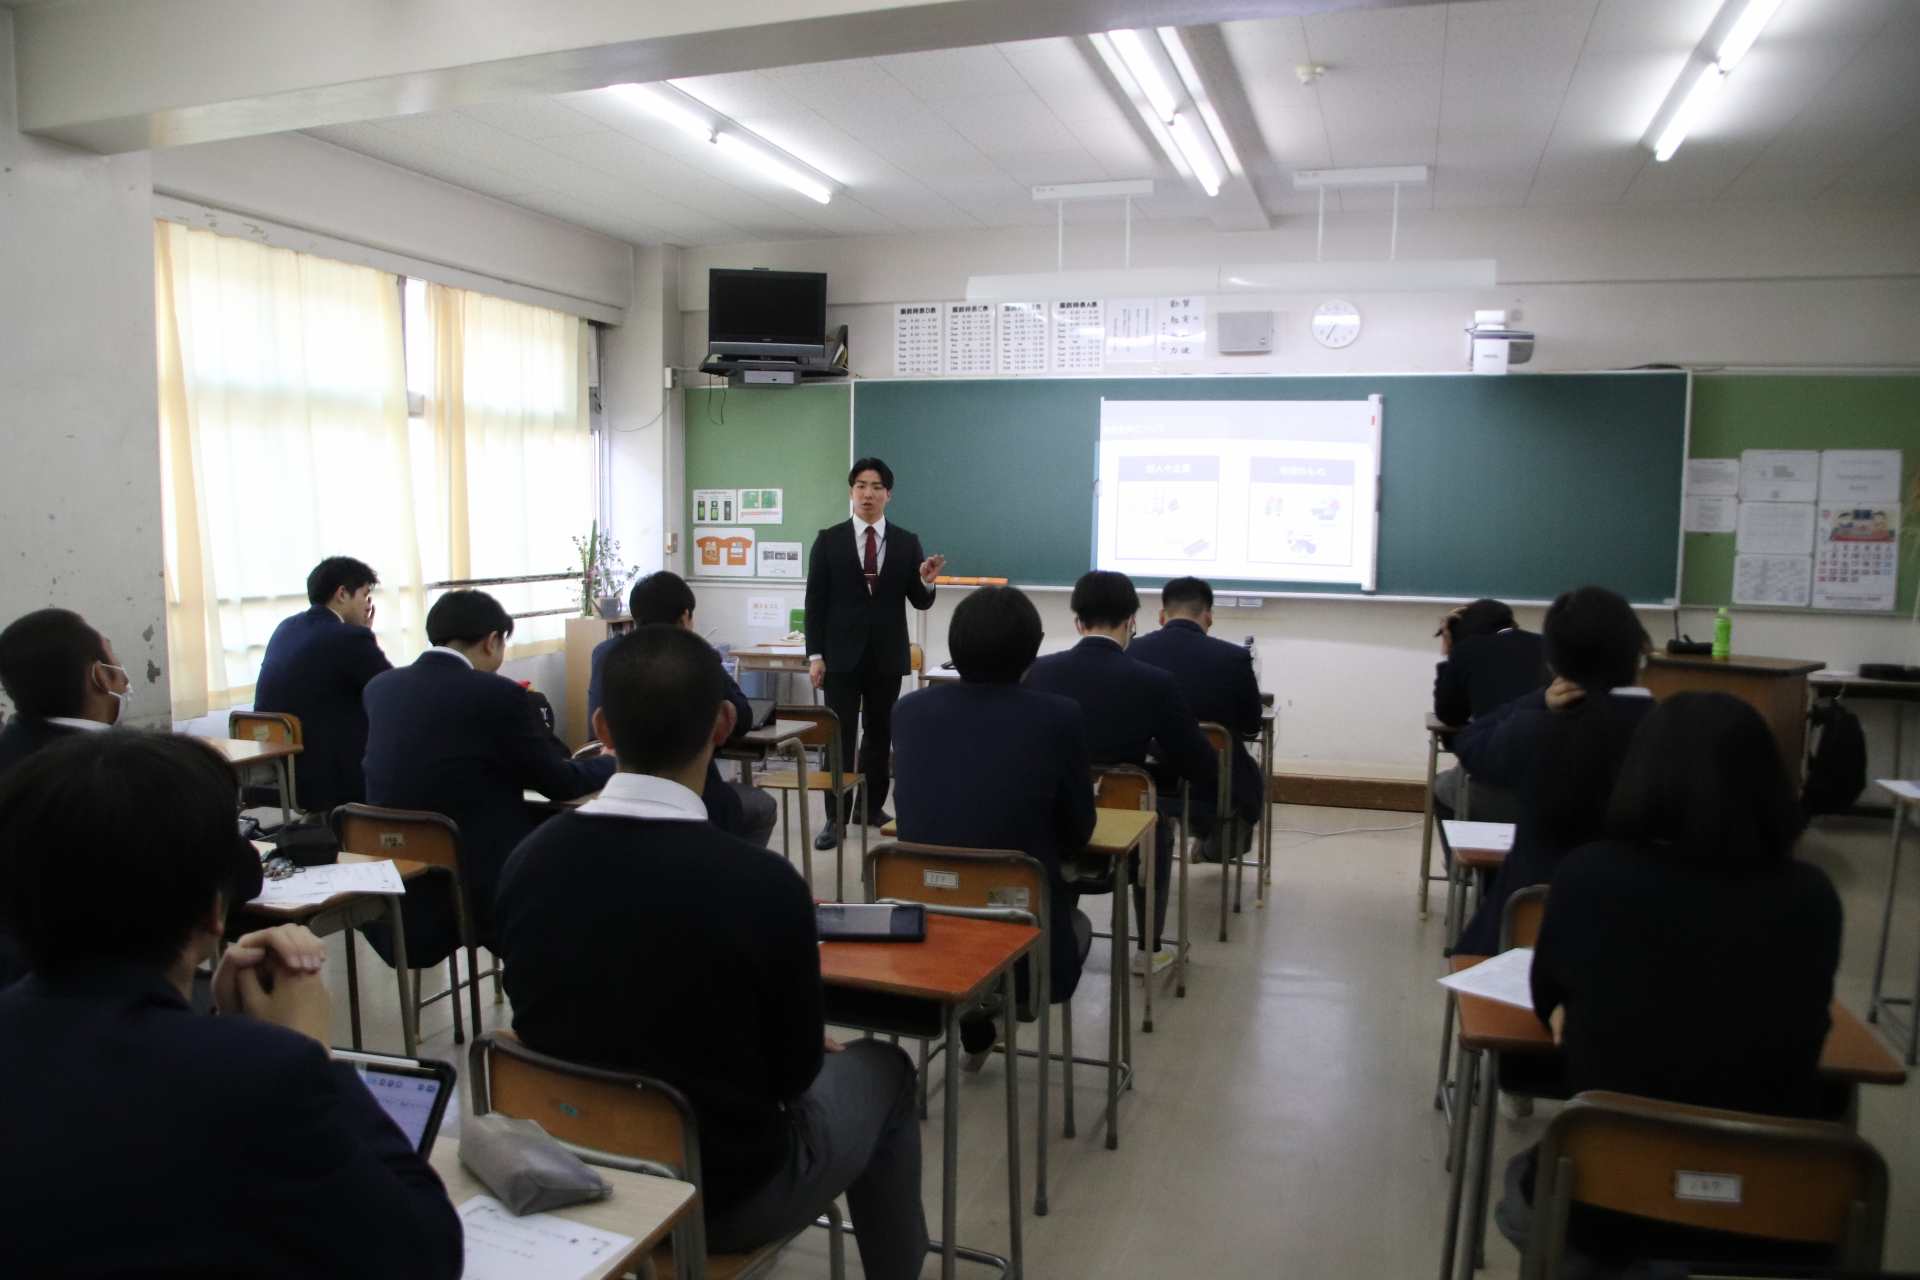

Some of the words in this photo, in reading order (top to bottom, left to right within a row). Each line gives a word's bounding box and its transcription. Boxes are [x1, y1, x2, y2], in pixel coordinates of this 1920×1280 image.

[1146, 464, 1191, 474] 個人や企業
[1279, 465, 1326, 476] 地域のもの
